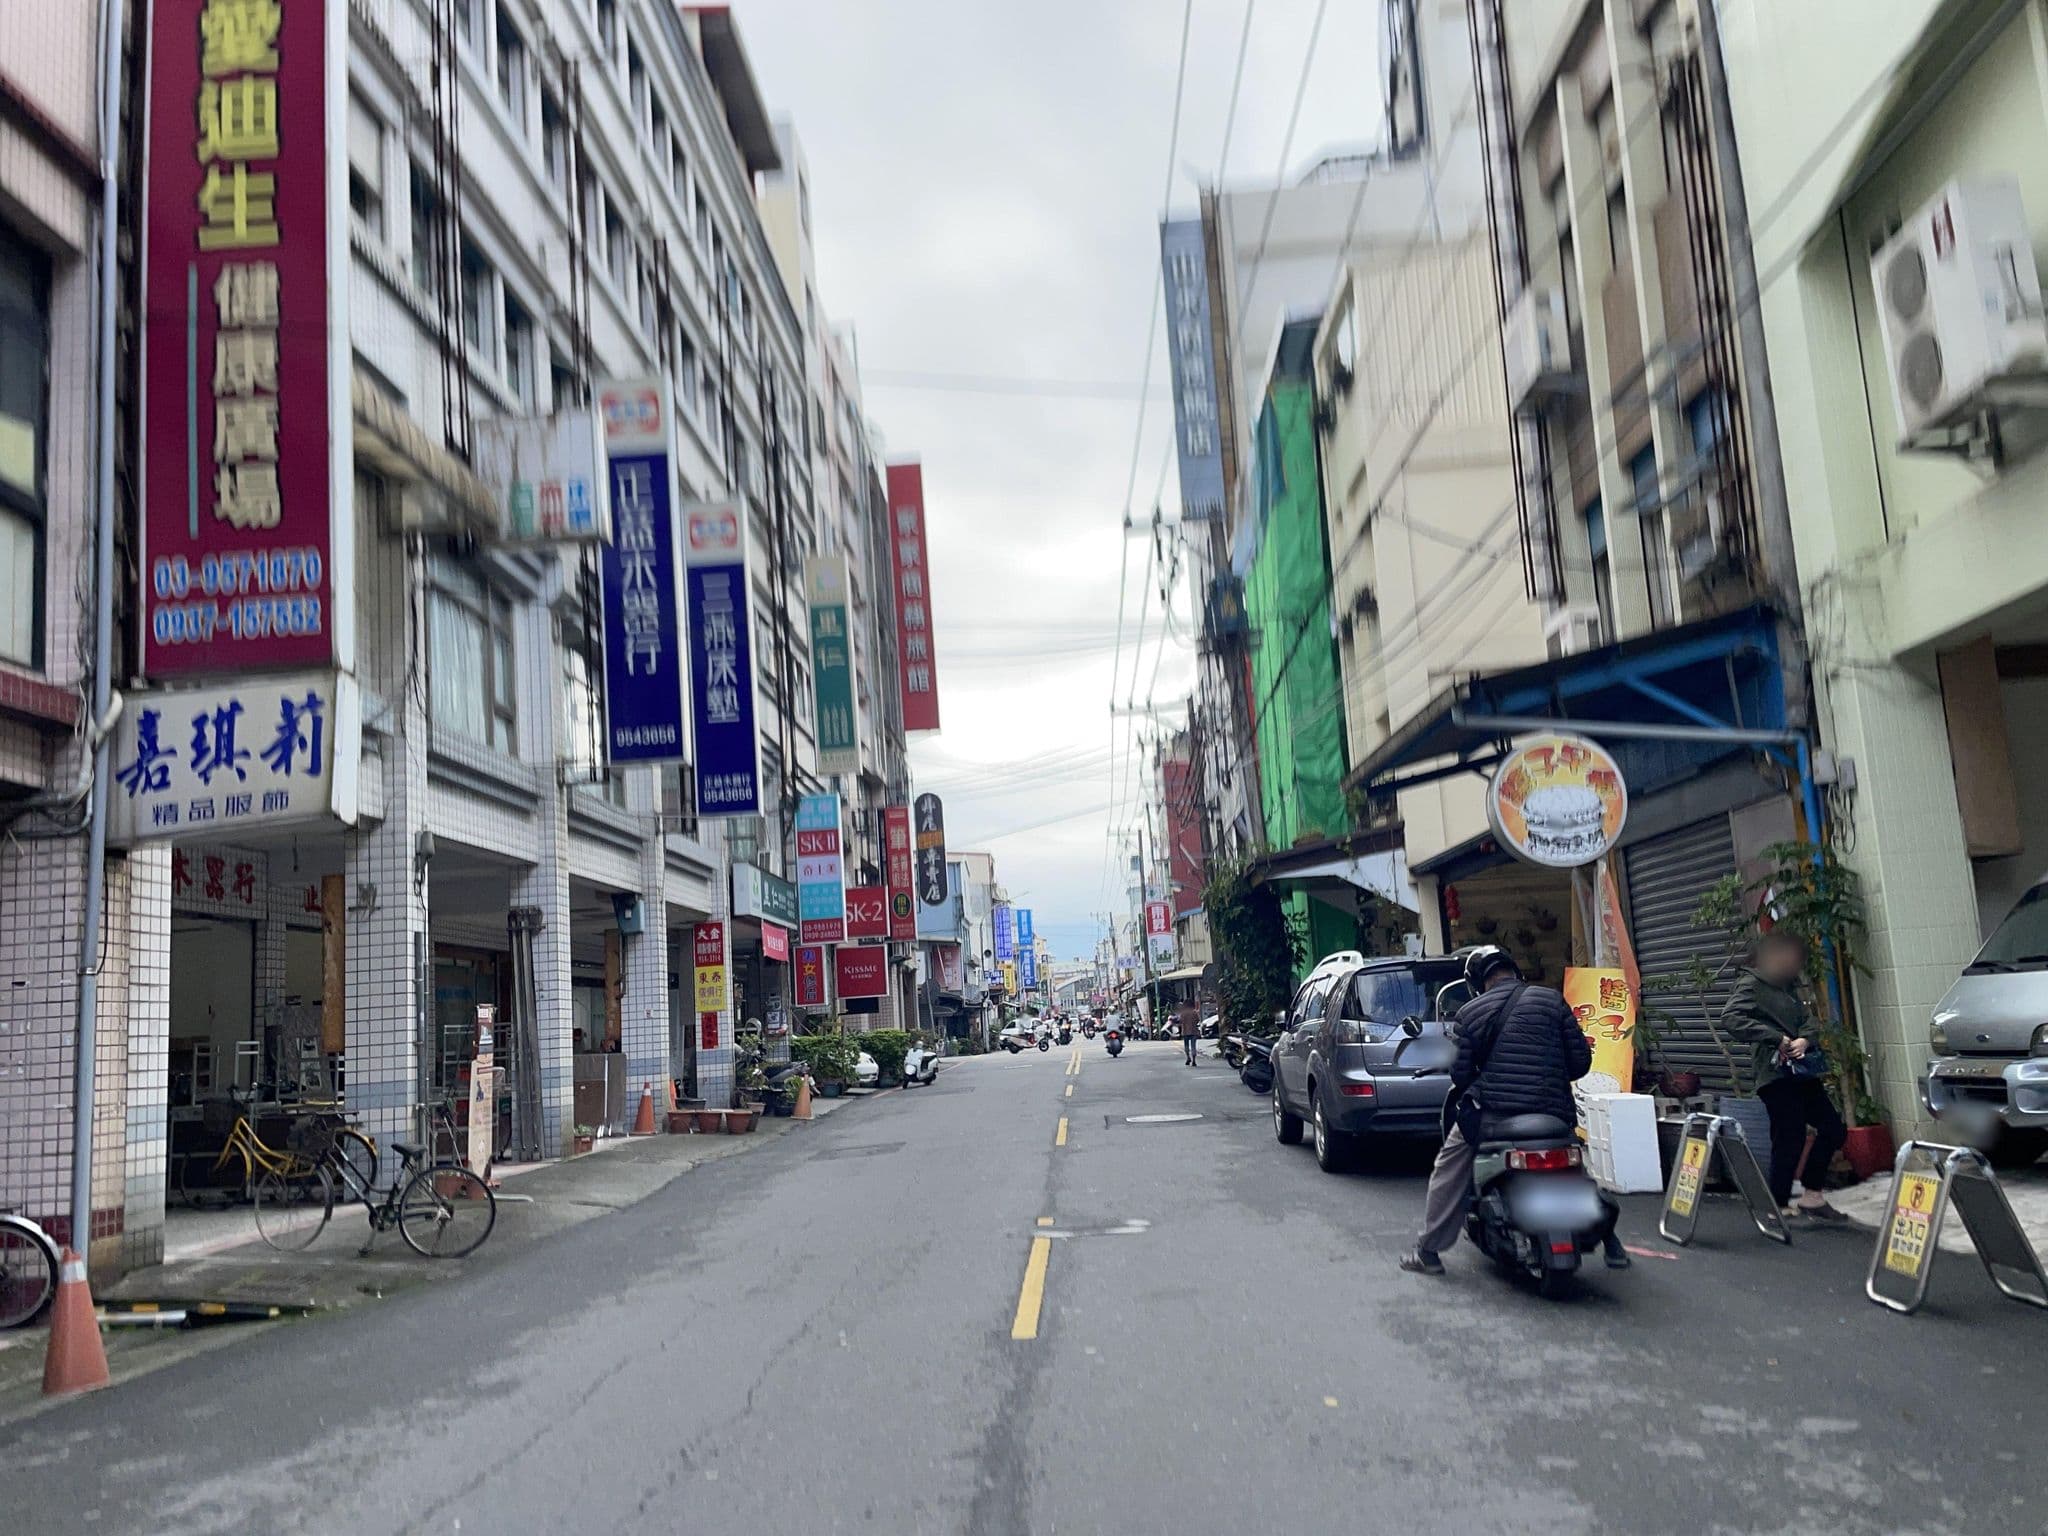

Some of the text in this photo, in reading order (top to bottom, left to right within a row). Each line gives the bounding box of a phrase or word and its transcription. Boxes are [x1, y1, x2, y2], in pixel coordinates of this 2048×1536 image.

[115, 689, 326, 799] 嘉琪莉
[152, 790, 289, 827] 精品服飾
[1896, 1217, 1926, 1241] 出入口
